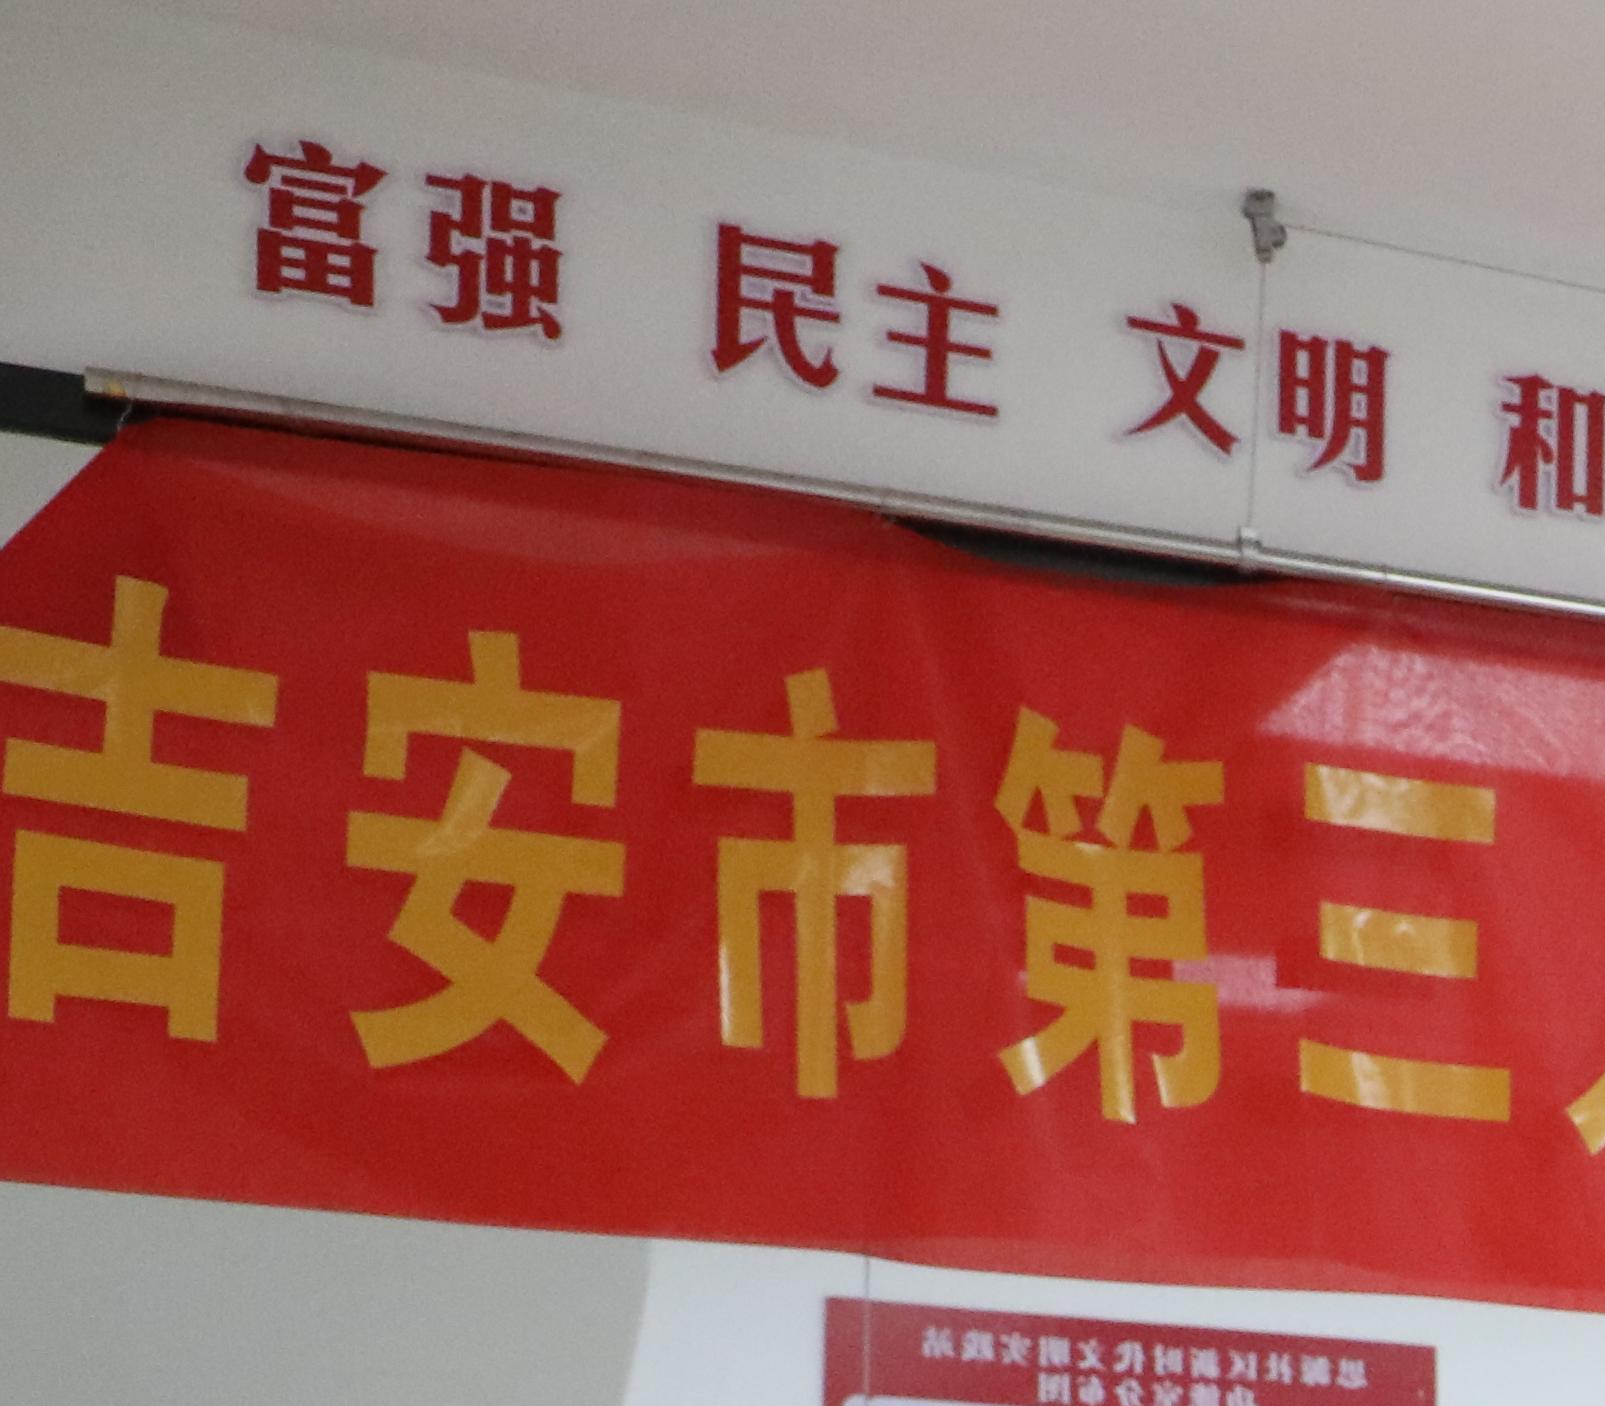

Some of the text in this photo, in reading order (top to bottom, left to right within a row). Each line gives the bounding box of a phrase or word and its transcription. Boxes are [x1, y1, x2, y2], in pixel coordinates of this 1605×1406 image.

[244, 141, 563, 341] 富强
[711, 223, 1000, 419] 民主
[1126, 302, 1390, 483] 文明
